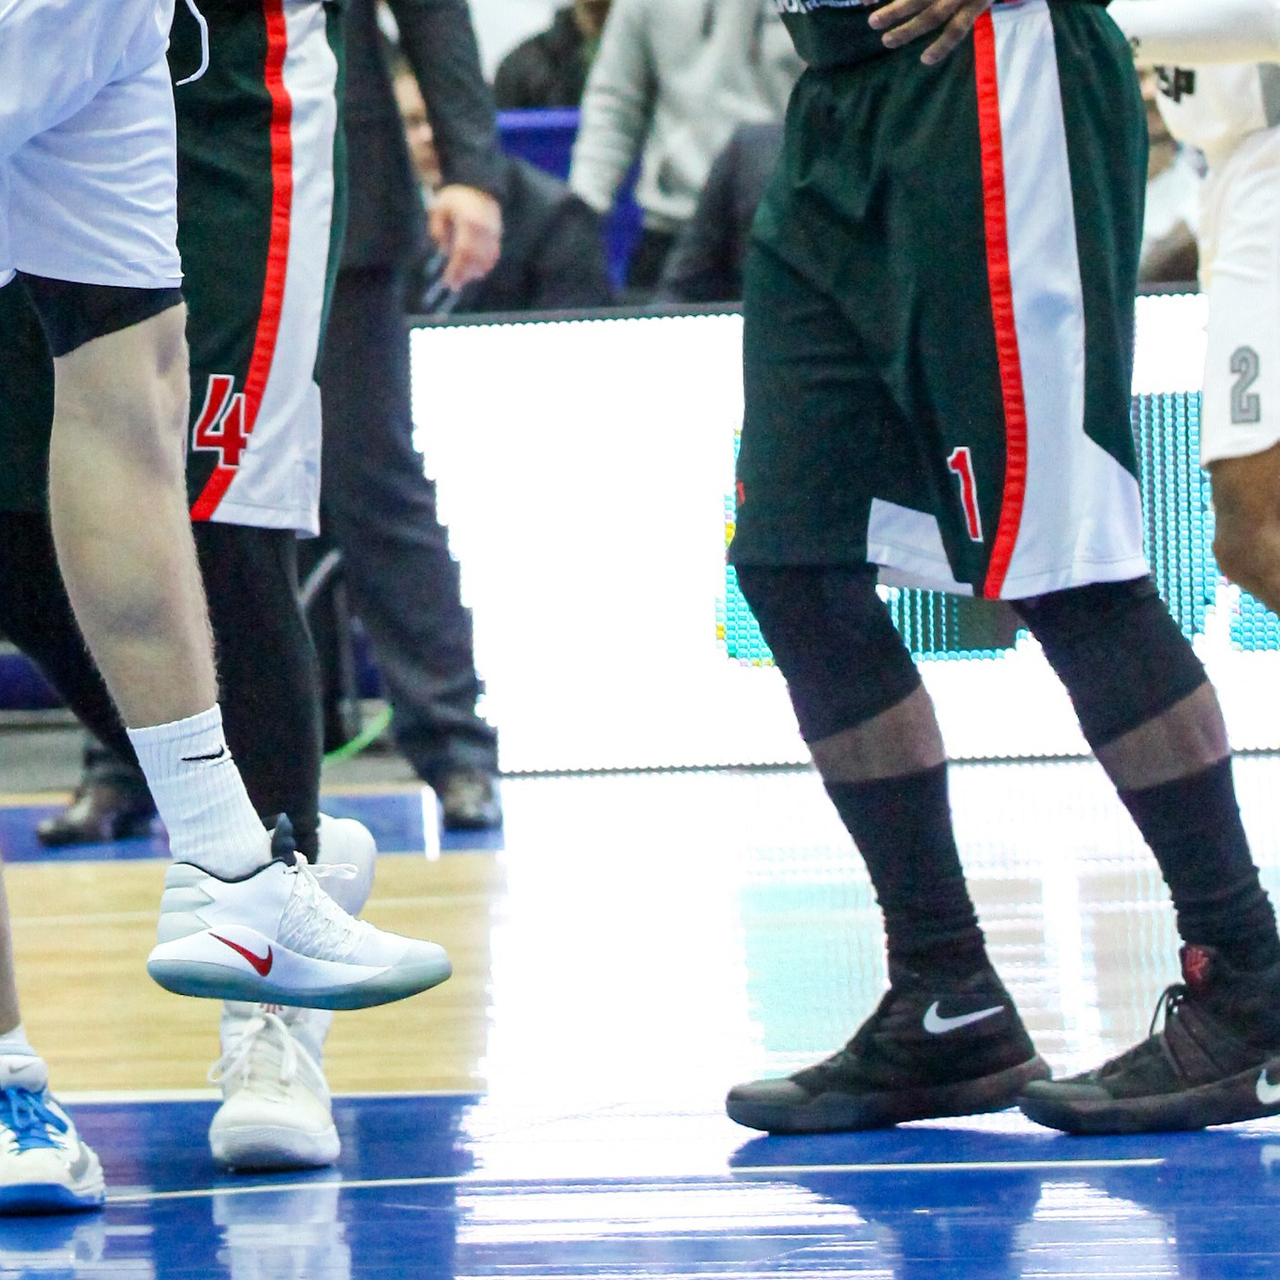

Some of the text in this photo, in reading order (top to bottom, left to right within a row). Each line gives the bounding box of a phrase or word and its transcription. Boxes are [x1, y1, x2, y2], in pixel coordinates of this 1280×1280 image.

[192, 373, 250, 469] 4
[1230, 345, 1261, 425] 2
[946, 446, 984, 542] 1
